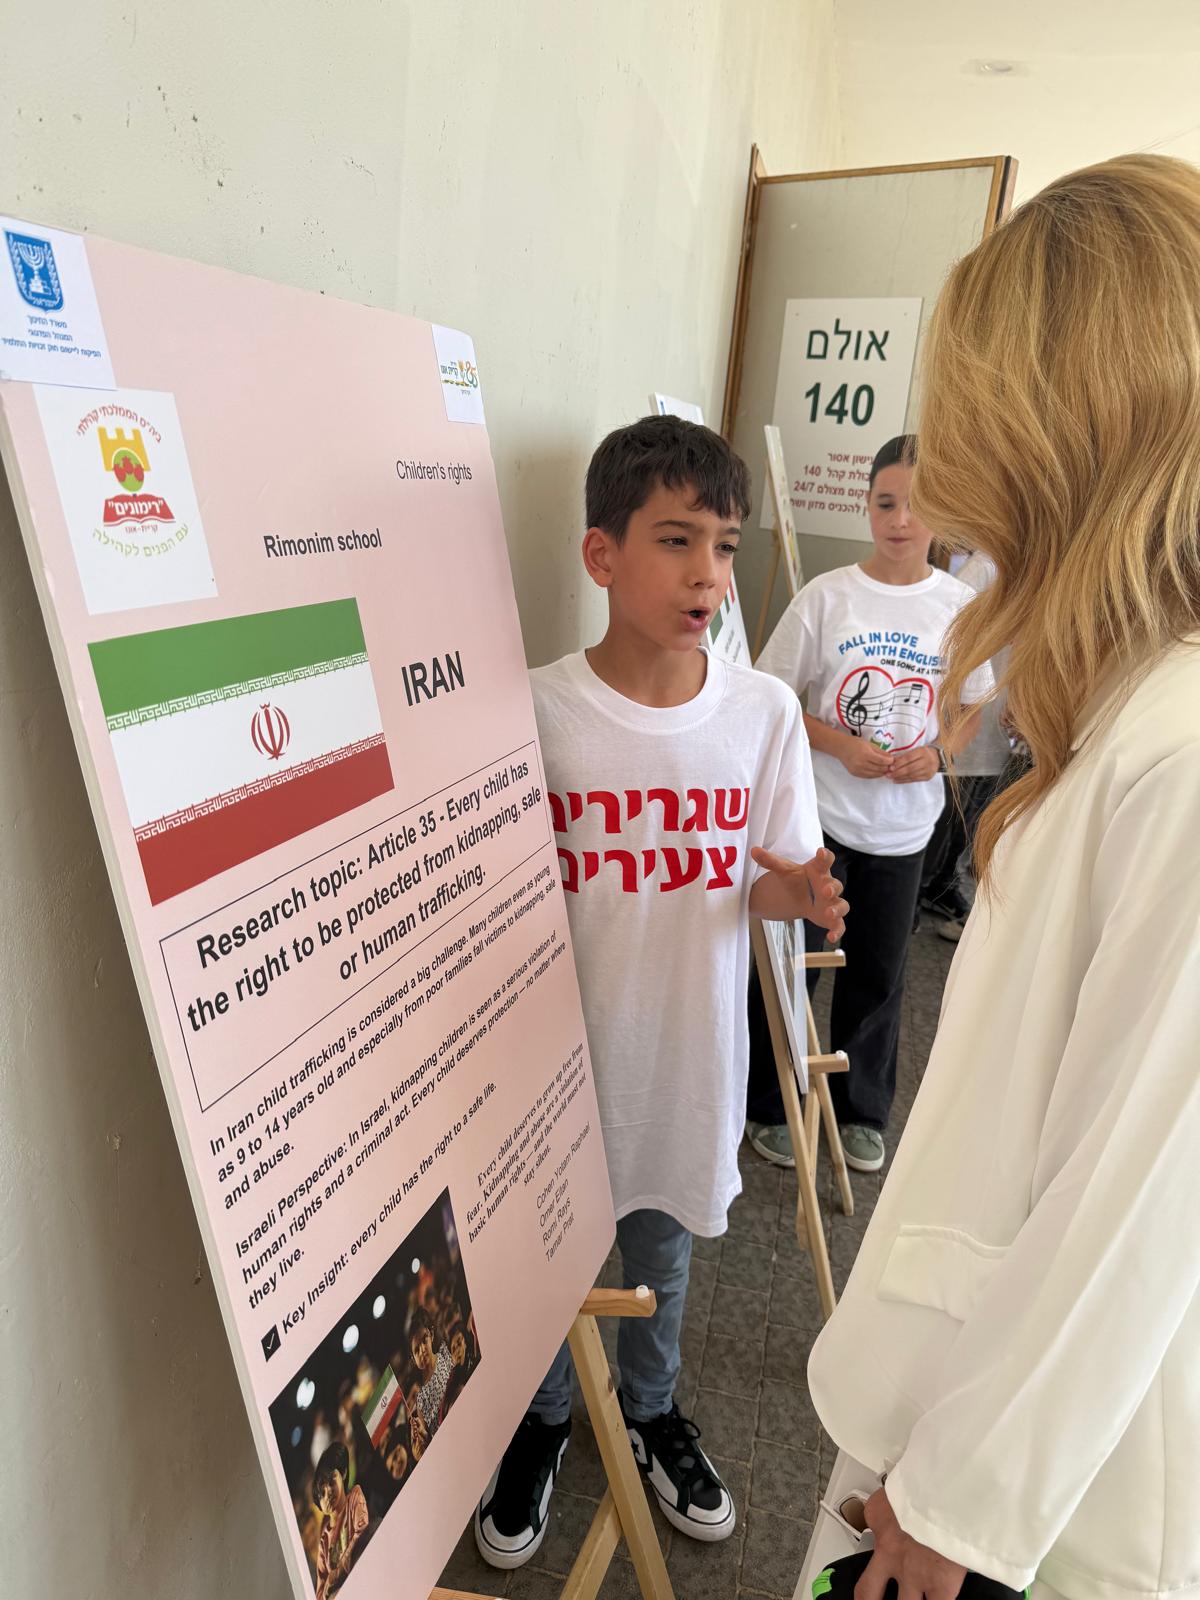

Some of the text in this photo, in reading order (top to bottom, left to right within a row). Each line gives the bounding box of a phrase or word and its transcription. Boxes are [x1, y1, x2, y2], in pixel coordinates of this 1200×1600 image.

[806, 318, 890, 361] אולם
[804, 382, 875, 426] 140
[396, 460, 472, 485] Children's rights
[804, 465, 846, 482] קהל 140
[828, 453, 850, 462] אסור
[794, 481, 845, 495] מצולם 24/7
[92, 528, 140, 558] לקהילה
[175, 524, 189, 542] עם
[263, 528, 382, 558] Rimonim school
[838, 632, 919, 655] FALL IN LOVE
[863, 645, 897, 657] WITH
[880, 658, 895, 667] ONE
[897, 662, 915, 672] SONG
[402, 650, 465, 706] IRAN
[196, 761, 528, 968] Research topic: Article 35 Every child has
[187, 786, 540, 1031] the right to be protected from kidnapping, sale
[339, 863, 485, 979] or human trafficking.
[210, 865, 550, 1155] In Iran child trafficking is considered a big challenge. Many children even as young
[218, 878, 555, 1182] as 9 to 14 years old and especially from poor families fall victims to kidnapping, sale
[235, 929, 556, 1257] Israeli Perspective: In Israel, kidnapping children is seen as a serious violation of
[242, 941, 565, 1284] human rights and a criminal act. Every child deserves protection no matter where
[224, 1142, 293, 1209] and abuse.
[282, 1082, 496, 1334] Key Insight: every child has the right to a safe life.
[248, 1248, 304, 1308] they live.
